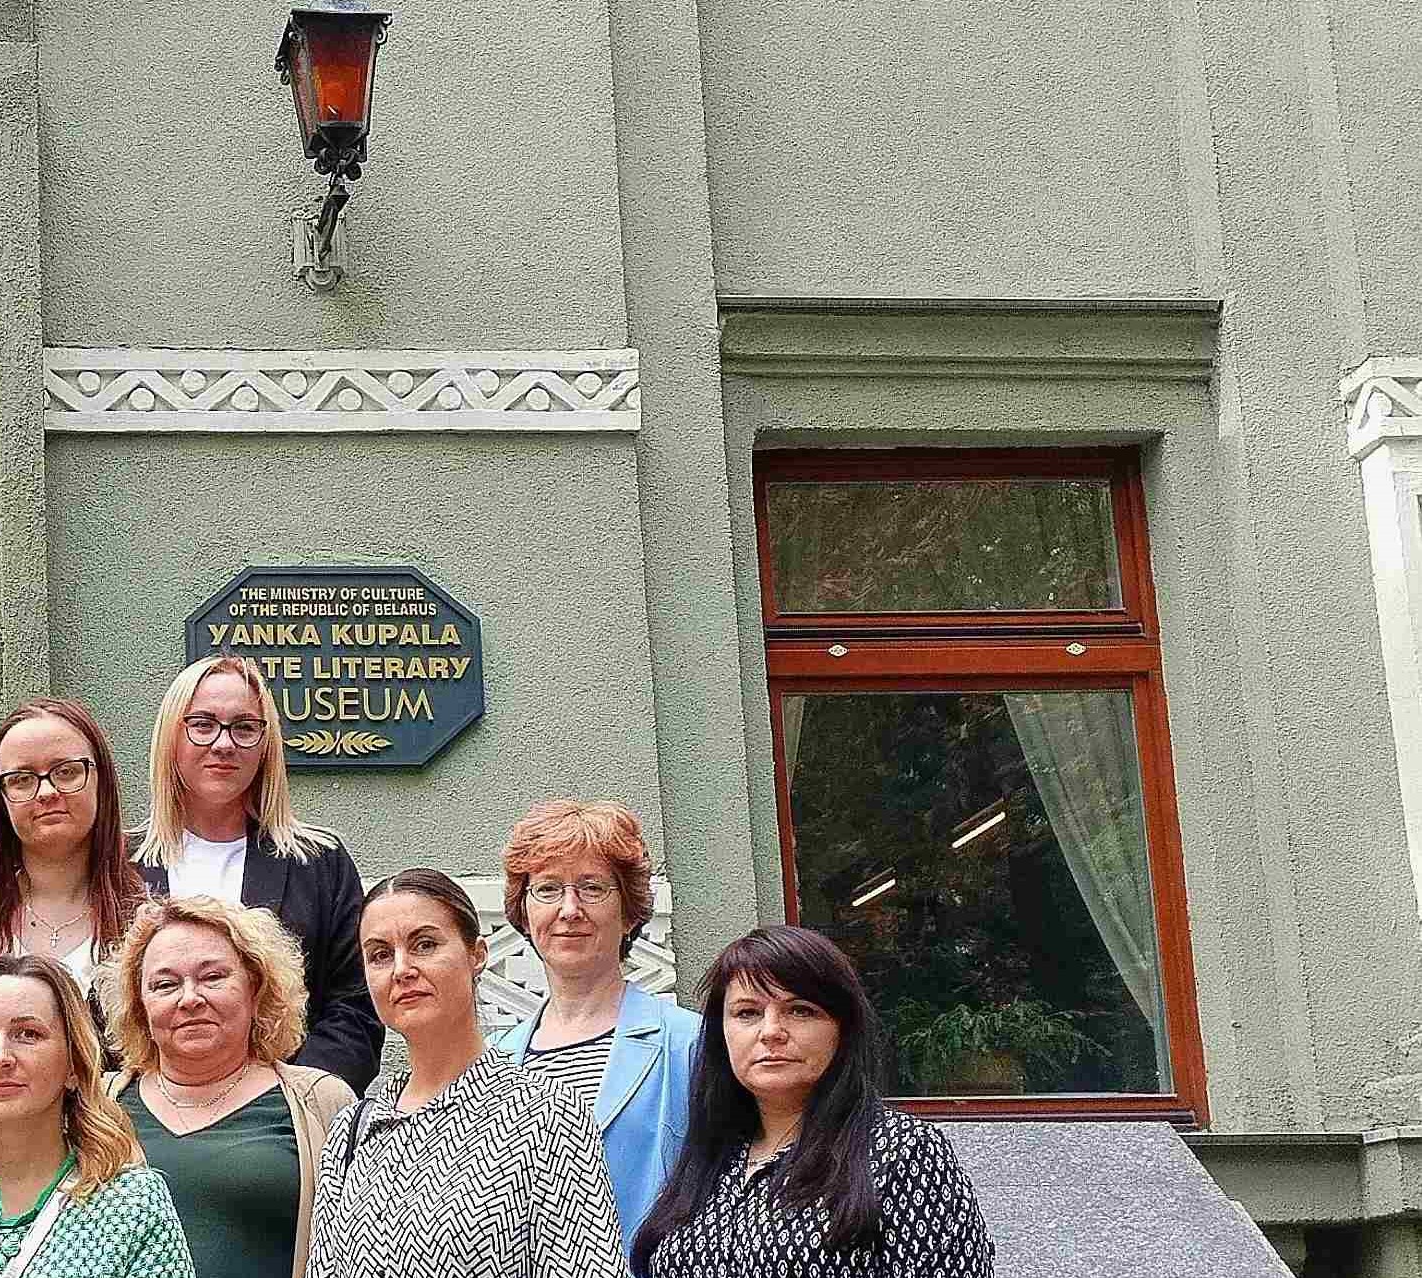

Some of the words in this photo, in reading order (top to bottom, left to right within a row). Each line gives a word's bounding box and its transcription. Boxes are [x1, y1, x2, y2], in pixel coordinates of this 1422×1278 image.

[239, 588, 267, 600] THE
[270, 588, 336, 600] MINISTRY
[340, 588, 357, 600] OF
[361, 588, 425, 600] CULTURE
[229, 604, 247, 616] OF
[252, 604, 278, 616] THE
[282, 604, 347, 616] REPUBLIC
[353, 604, 369, 616] OF
[375, 604, 437, 616] BELARUS
[208, 624, 321, 646] YANKA
[332, 624, 461, 646] KUPALA
[313, 656, 471, 679] LITERARY
[271, 687, 434, 721] USEUM
